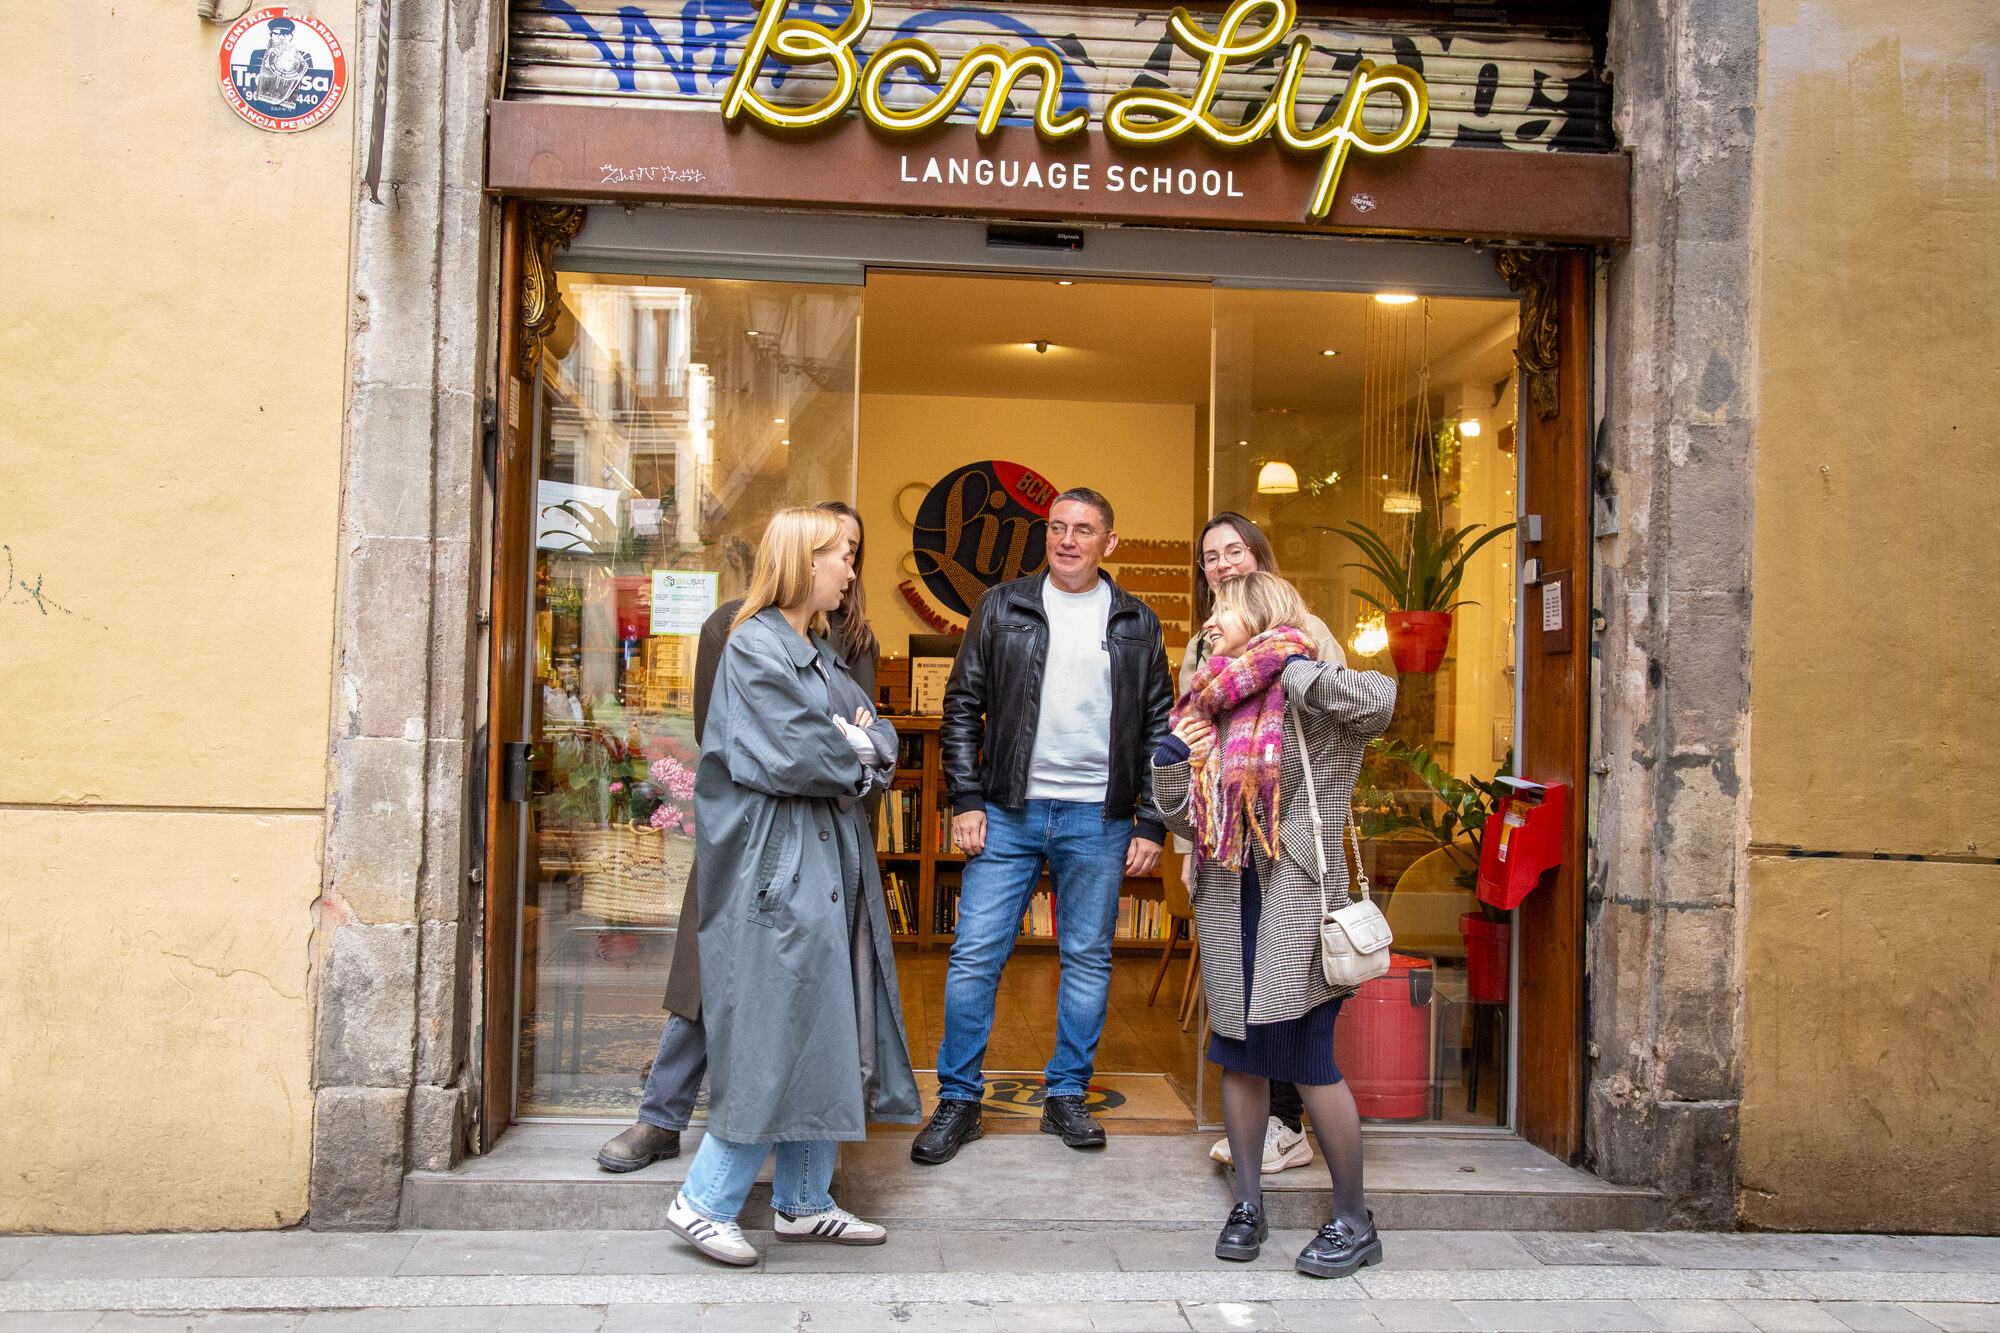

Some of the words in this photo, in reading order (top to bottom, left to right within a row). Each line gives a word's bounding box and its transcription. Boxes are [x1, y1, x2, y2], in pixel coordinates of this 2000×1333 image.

[224, 10, 275, 51] CENTRAL
[280, 83, 342, 129] PERMANENT
[296, 94, 319, 105] 440
[720, 0, 1091, 143] Bcn
[1103, 0, 1429, 225] Lip
[901, 155, 1091, 190] LANGUAGE
[1106, 165, 1244, 197] SCHOOL
[1016, 471, 1054, 506] BCN
[1119, 567, 1188, 577] RECEPCION
